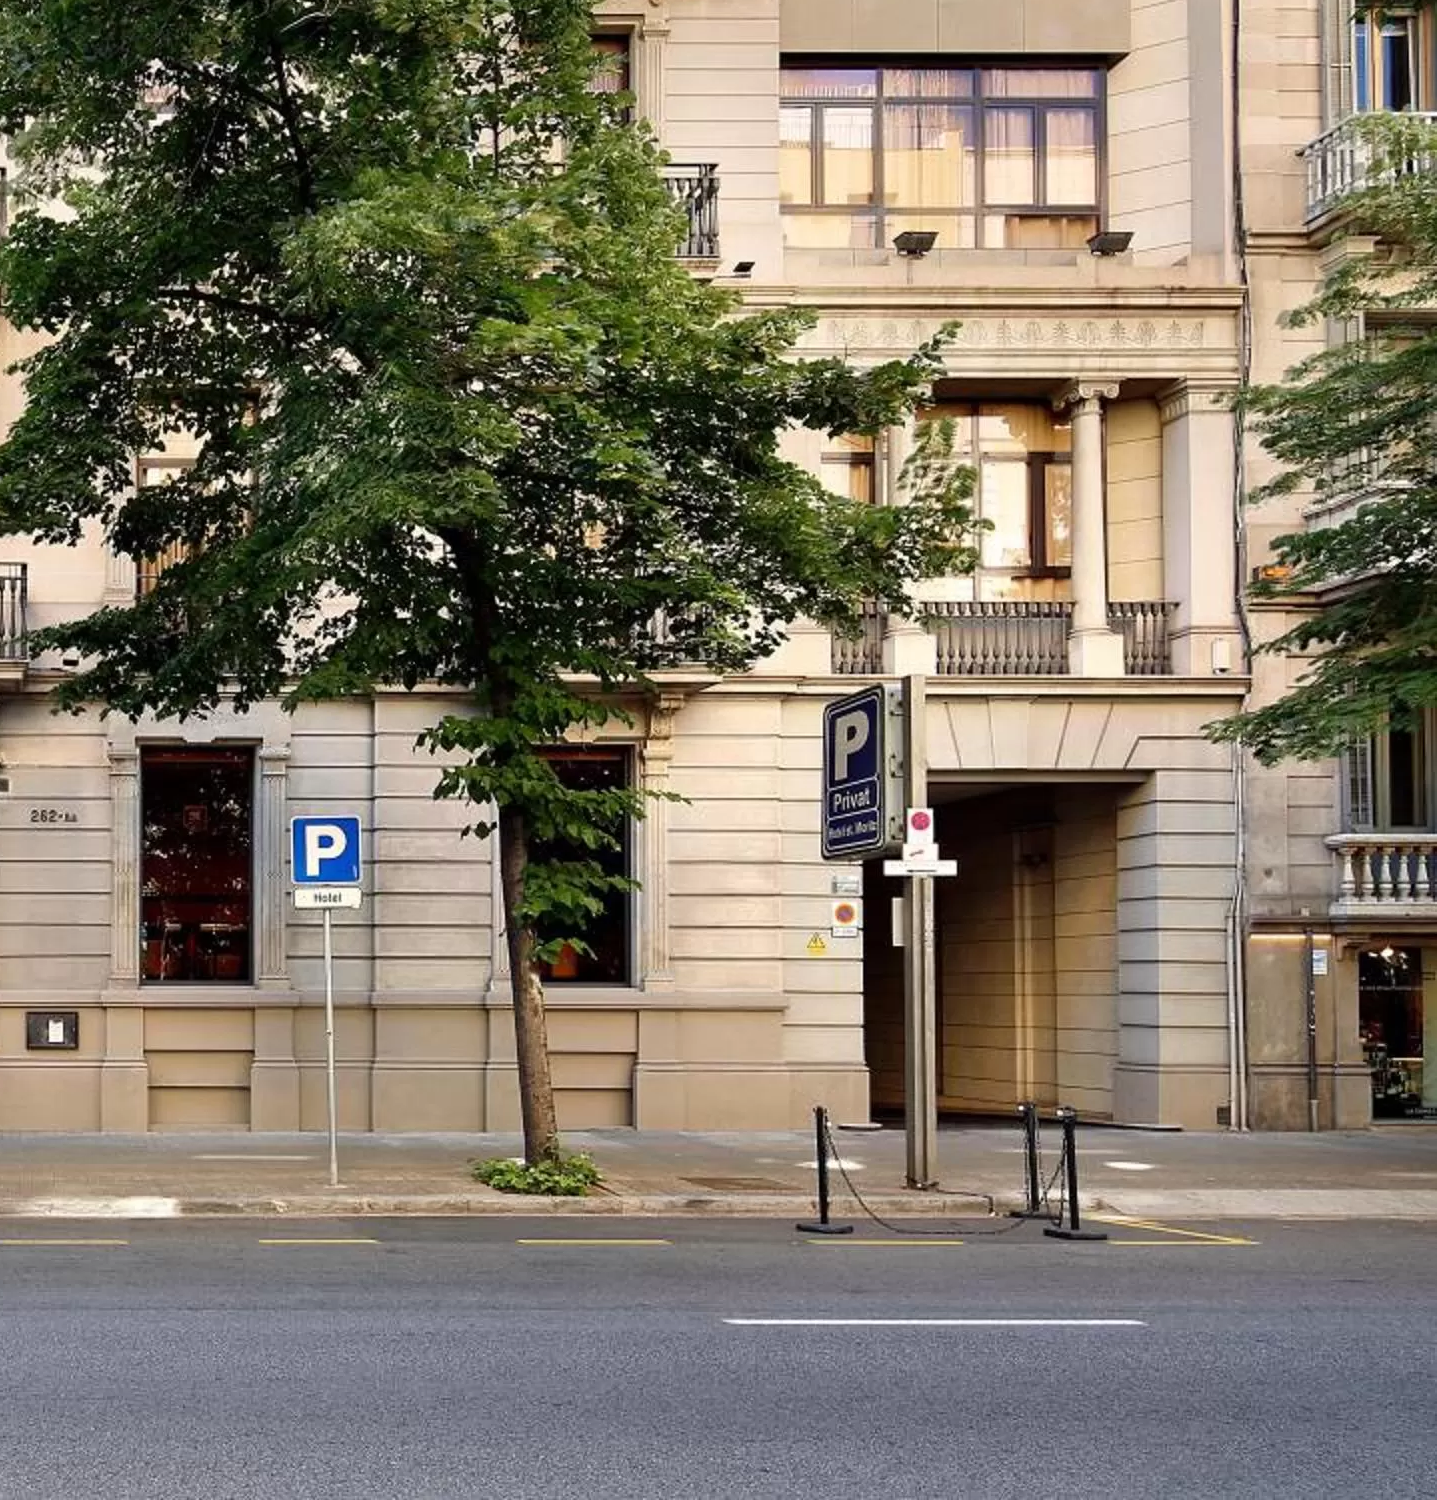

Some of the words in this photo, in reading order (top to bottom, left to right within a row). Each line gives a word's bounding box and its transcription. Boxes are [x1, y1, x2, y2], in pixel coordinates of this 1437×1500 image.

[834, 710, 870, 781] P
[834, 787, 870, 813] Privat
[305, 825, 347, 877] P
[314, 891, 343, 903] Hotel
